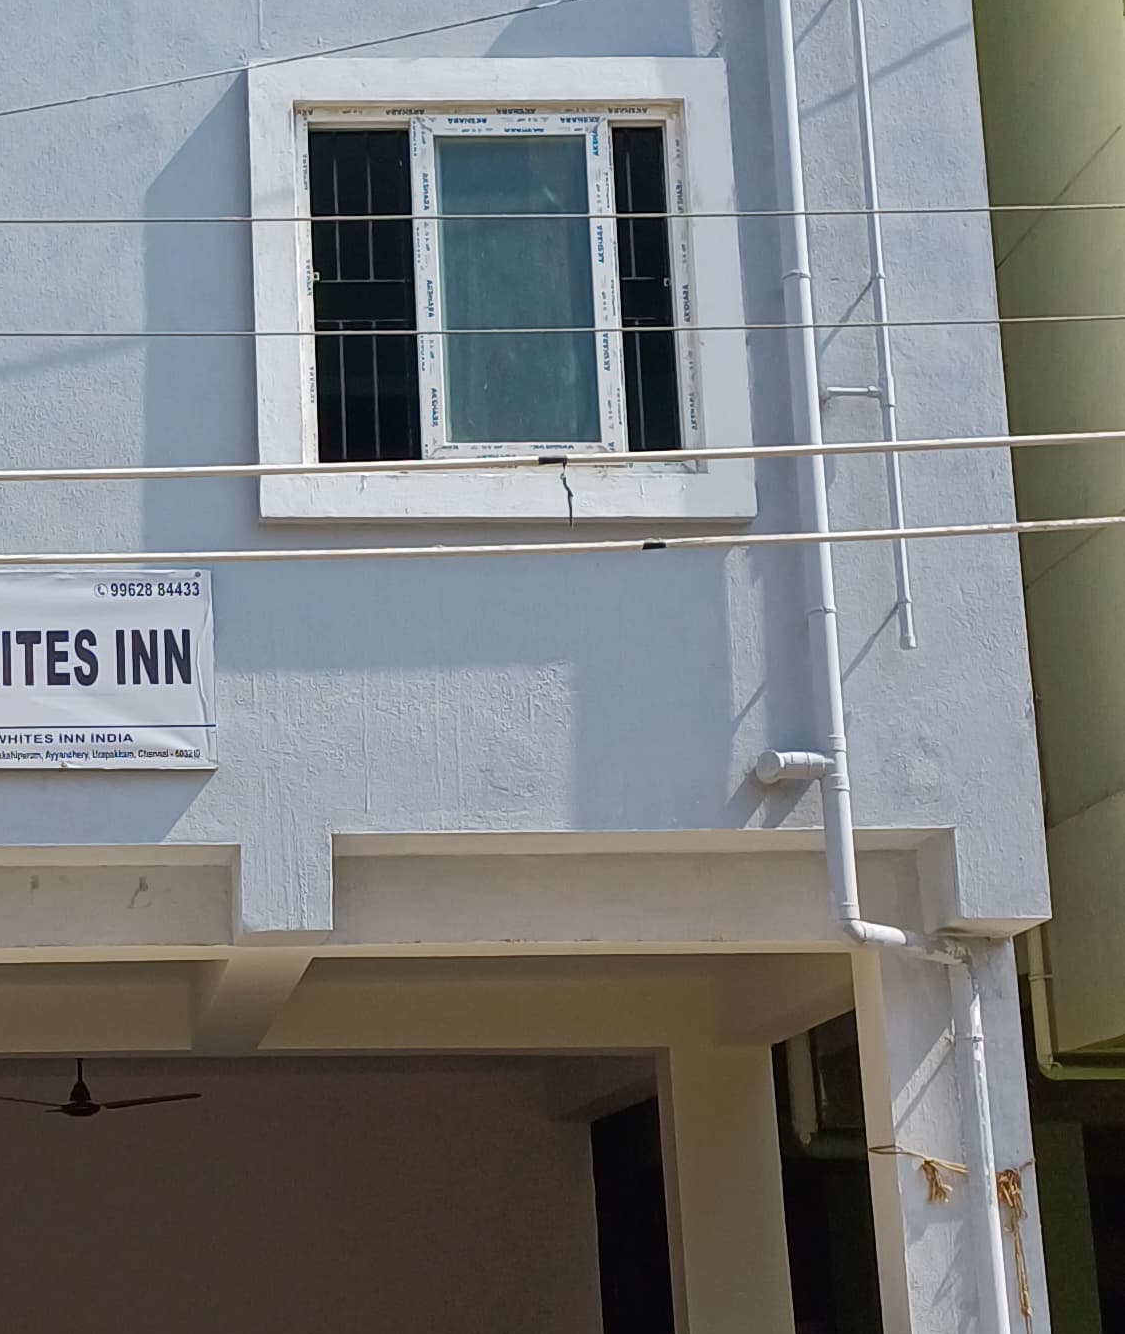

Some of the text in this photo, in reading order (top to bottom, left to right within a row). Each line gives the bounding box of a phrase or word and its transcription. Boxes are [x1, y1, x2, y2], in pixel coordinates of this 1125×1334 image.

[110, 581, 200, 597] 99628 84433
[115, 629, 192, 685] INN
[59, 733, 85, 743] INN
[90, 732, 134, 743] INDIA
